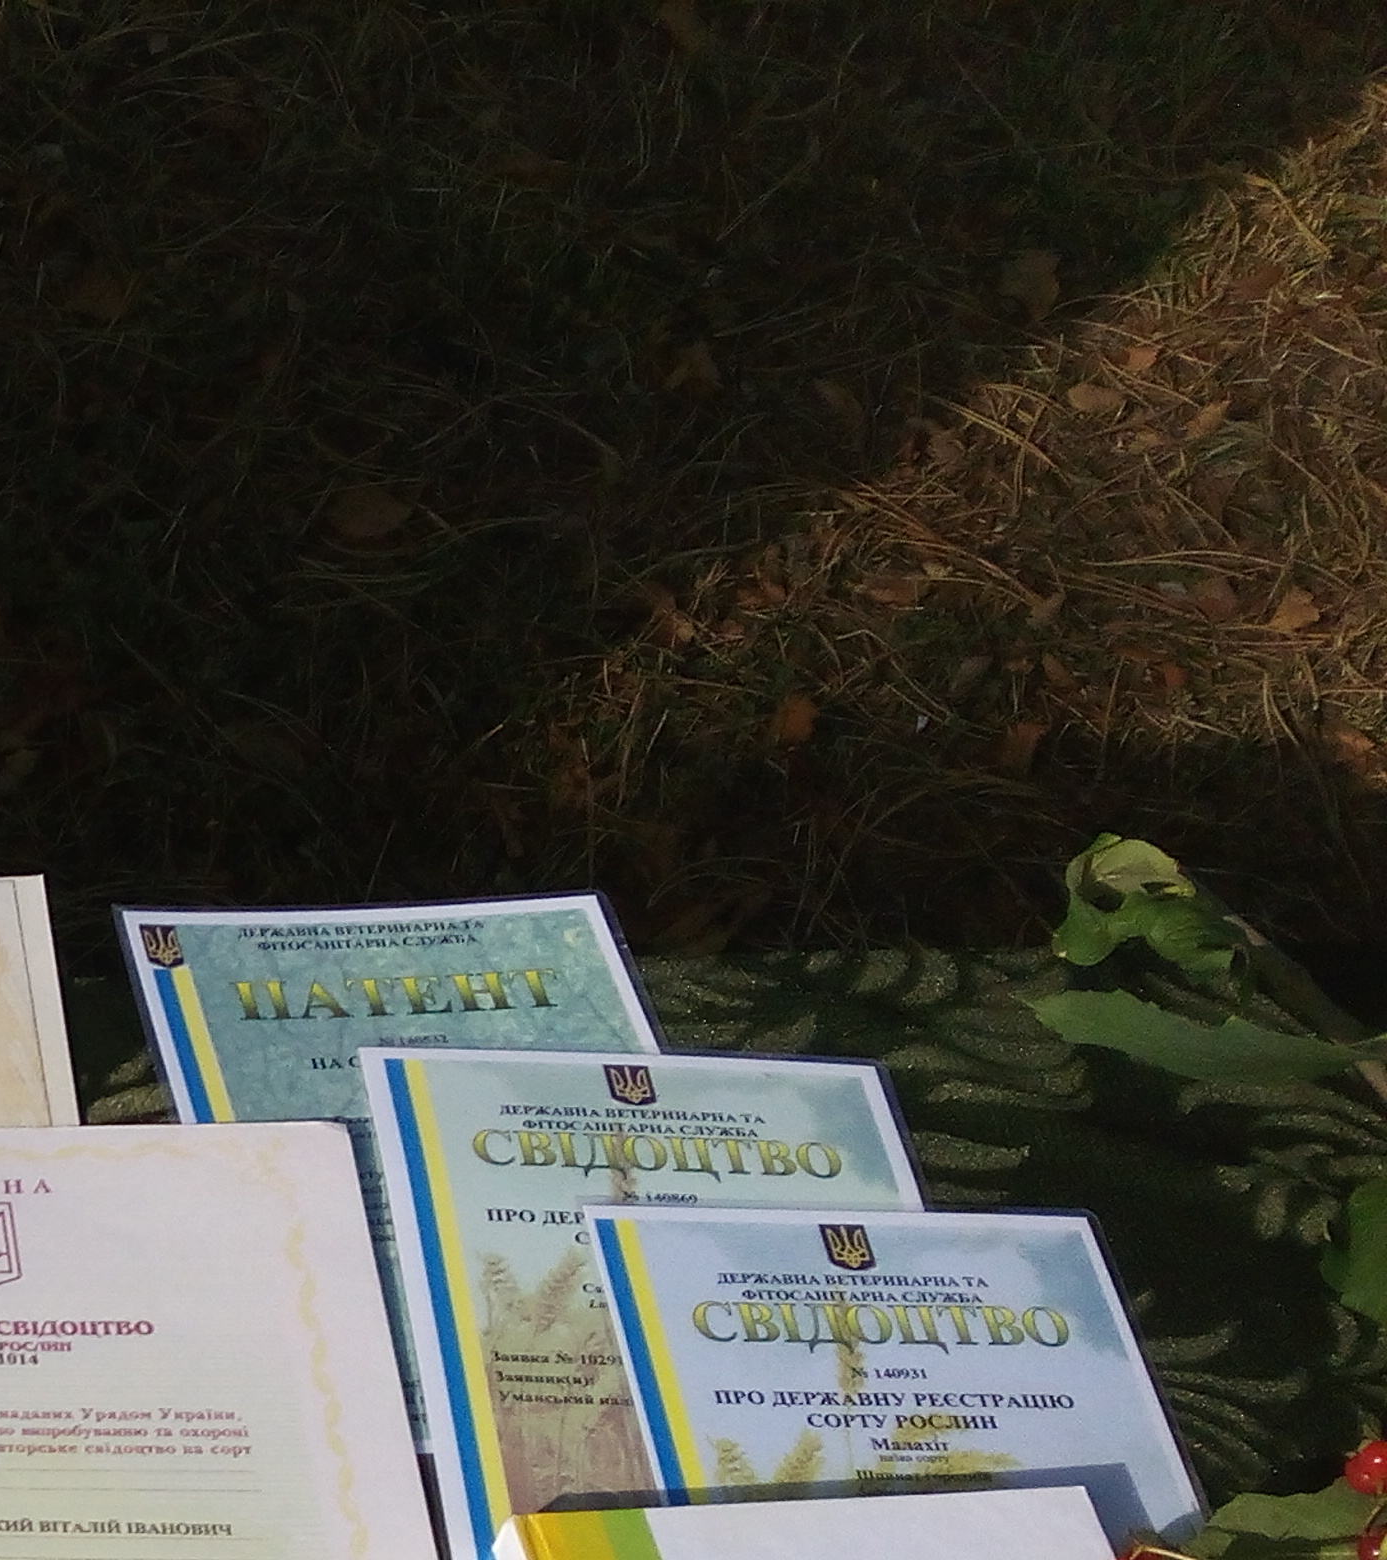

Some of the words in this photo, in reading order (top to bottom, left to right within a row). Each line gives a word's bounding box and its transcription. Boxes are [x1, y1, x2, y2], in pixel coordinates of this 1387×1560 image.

[237, 924, 329, 939] ДЕРЖАВНА
[230, 967, 564, 1021] ПАТЕНТ
[500, 1104, 600, 1118] ДЕРЖАВНА
[605, 1107, 735, 1123] ВЕТЕРИНАРНА
[522, 1119, 676, 1135] ФІТОСАНІТАРНА
[680, 1125, 758, 1138] СЛУЖБА
[472, 1128, 843, 1182] СВІДОЦТВО
[486, 1208, 536, 1223] ПРО
[717, 1272, 818, 1286] ДЕРЖАВНА
[824, 1274, 958, 1288] ВЕТЕРИНАРНА
[741, 1289, 897, 1302] ФІТОСАНІТАРНА
[901, 1291, 983, 1304] СЛУЖБА
[693, 1300, 1069, 1354] СВІДОЦТВО
[875, 1367, 928, 1380] 140931
[713, 1389, 765, 1406] ПРО
[772, 1391, 906, 1408] ДЕРЖАВНУ
[913, 1393, 1076, 1411] РЕЄСТРАЦІЮ
[807, 1413, 887, 1429] СОРТУ
[894, 1414, 999, 1430] РОСЛИН
[871, 1434, 950, 1452] Малахіт
[39, 1518, 122, 1534] ВІТАЛІЙ
[126, 1522, 233, 1537] ІВАНОВИЧ
